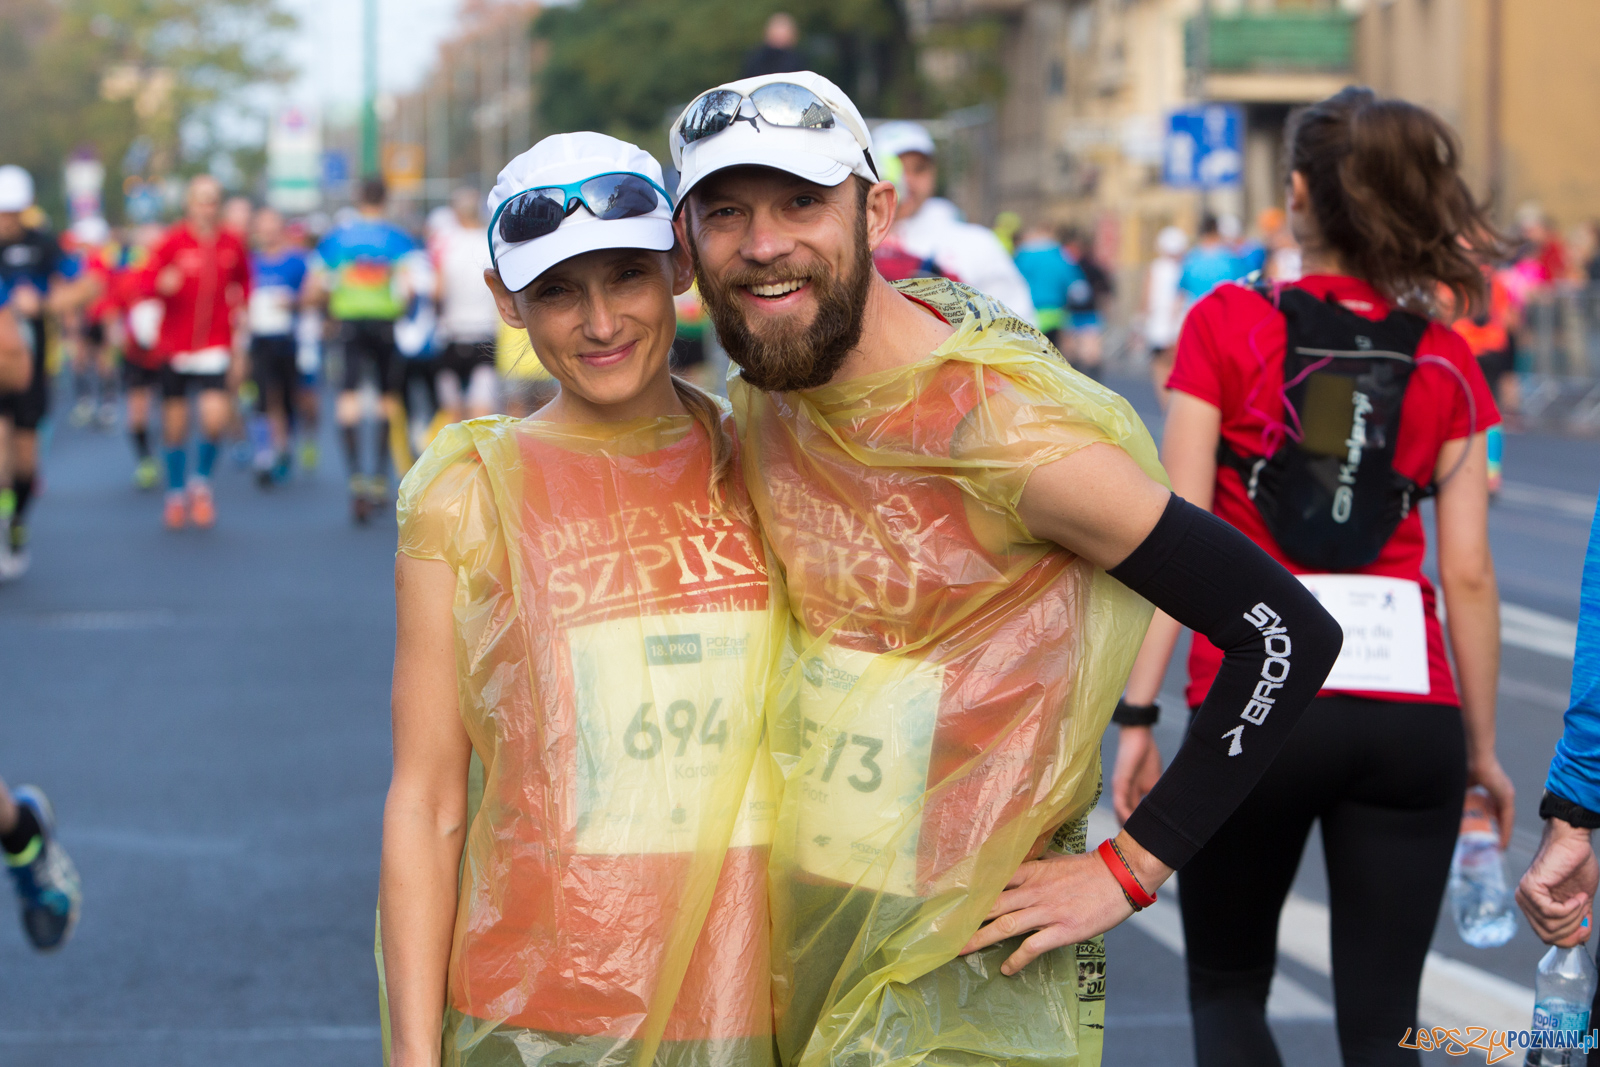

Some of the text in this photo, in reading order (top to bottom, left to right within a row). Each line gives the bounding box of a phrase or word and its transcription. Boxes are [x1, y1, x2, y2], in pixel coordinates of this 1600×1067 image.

[669, 641, 698, 656] PKO
[1240, 602, 1292, 726] BROOKS
[826, 664, 860, 685] POZna
[623, 697, 768, 760] 694
